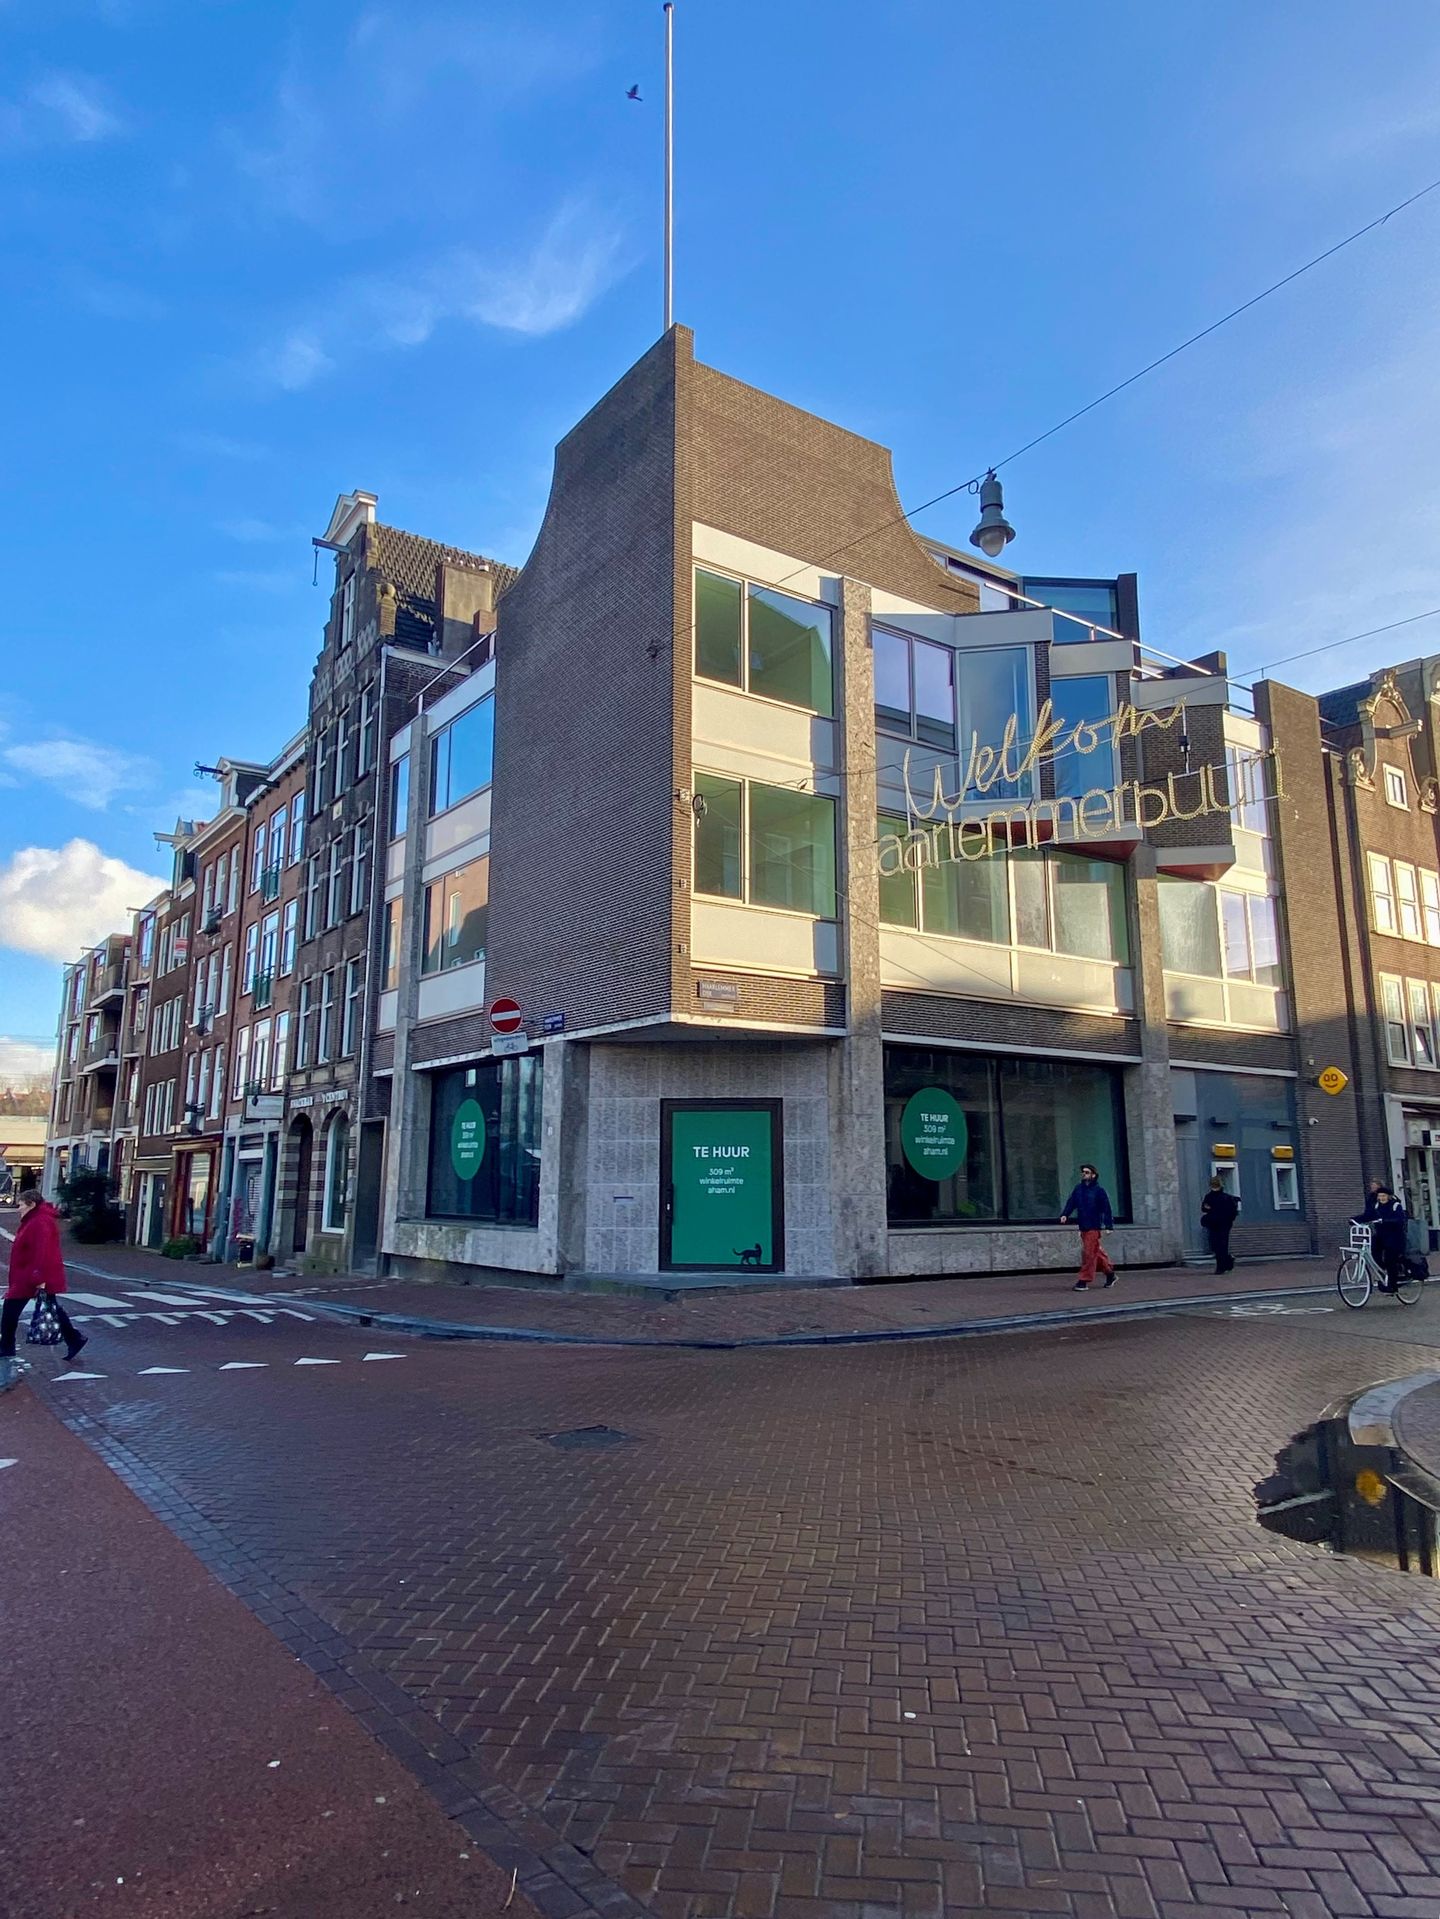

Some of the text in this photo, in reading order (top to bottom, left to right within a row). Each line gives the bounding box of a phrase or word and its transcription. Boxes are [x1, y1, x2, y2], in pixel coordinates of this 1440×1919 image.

[903, 697, 1187, 819] Welkom
[921, 1113, 949, 1123] TE HUUR
[692, 1146, 750, 1158] TE HUUR
[698, 1176, 745, 1185] winkelruimte
